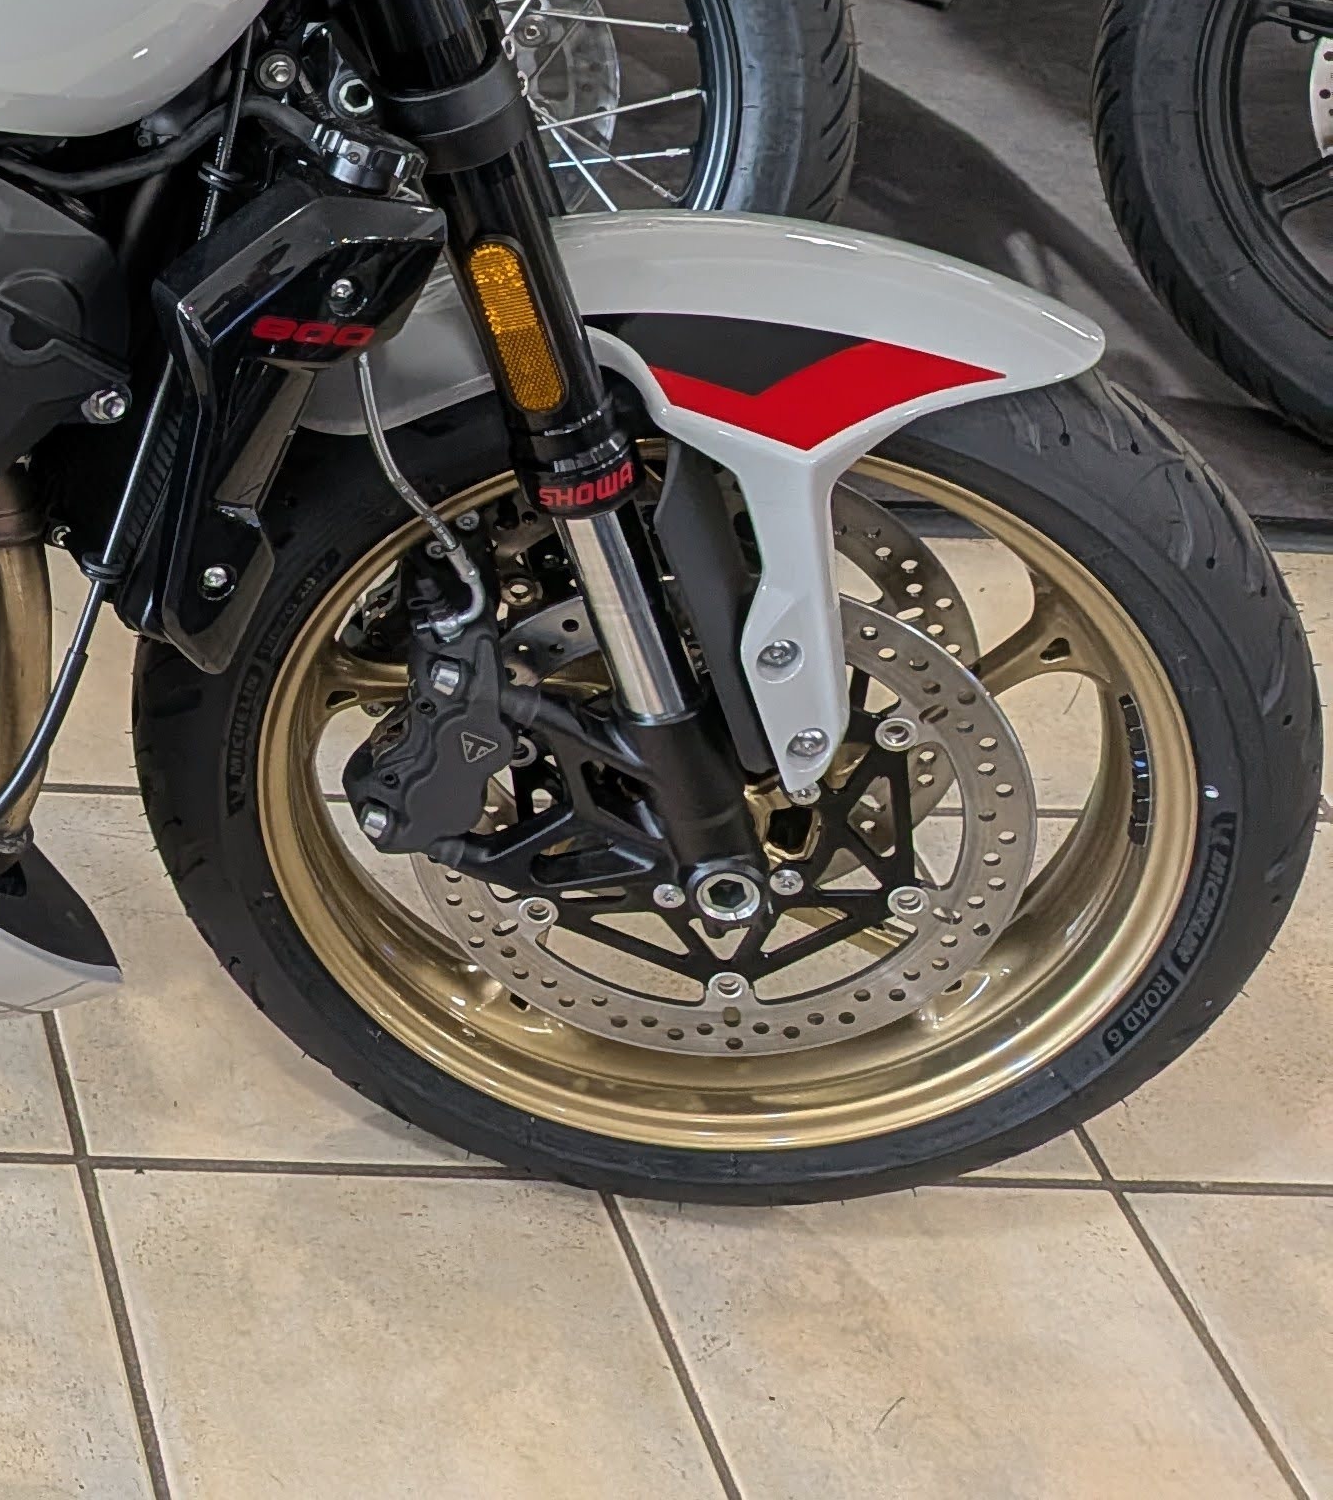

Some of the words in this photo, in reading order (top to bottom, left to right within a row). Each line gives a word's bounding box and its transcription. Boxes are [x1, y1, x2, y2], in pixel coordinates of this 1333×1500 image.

[252, 315, 376, 347] 800
[539, 461, 634, 508] SHOWA
[1123, 973, 1181, 1035] ROAD
